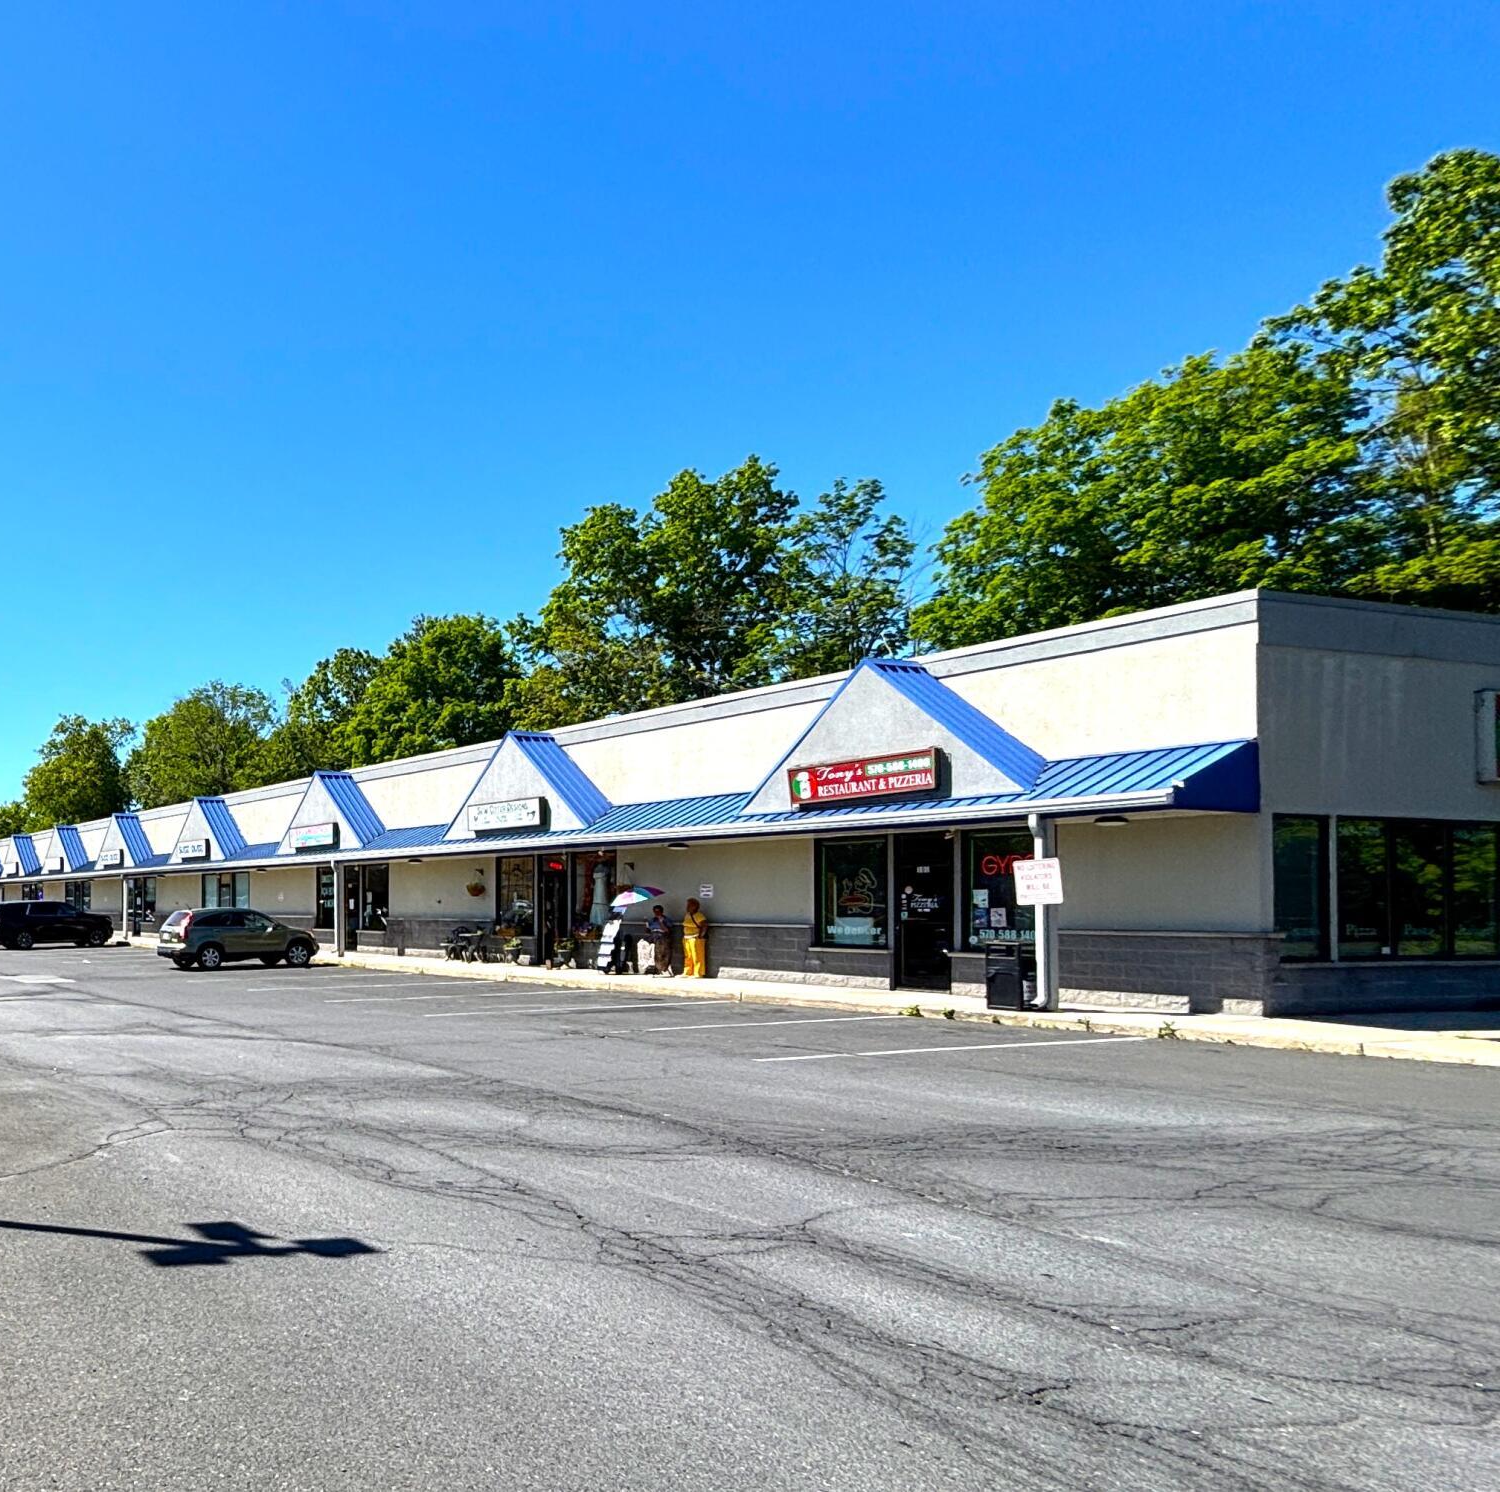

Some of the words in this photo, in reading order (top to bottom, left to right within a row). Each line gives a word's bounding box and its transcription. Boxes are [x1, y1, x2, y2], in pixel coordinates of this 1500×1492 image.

[816, 764, 863, 782] Tony's
[817, 779, 876, 797] RESTAURANT
[878, 777, 887, 790] &
[888, 772, 933, 788] PIZZERIA
[979, 929, 995, 939] 570
[998, 929, 1017, 940] 588
